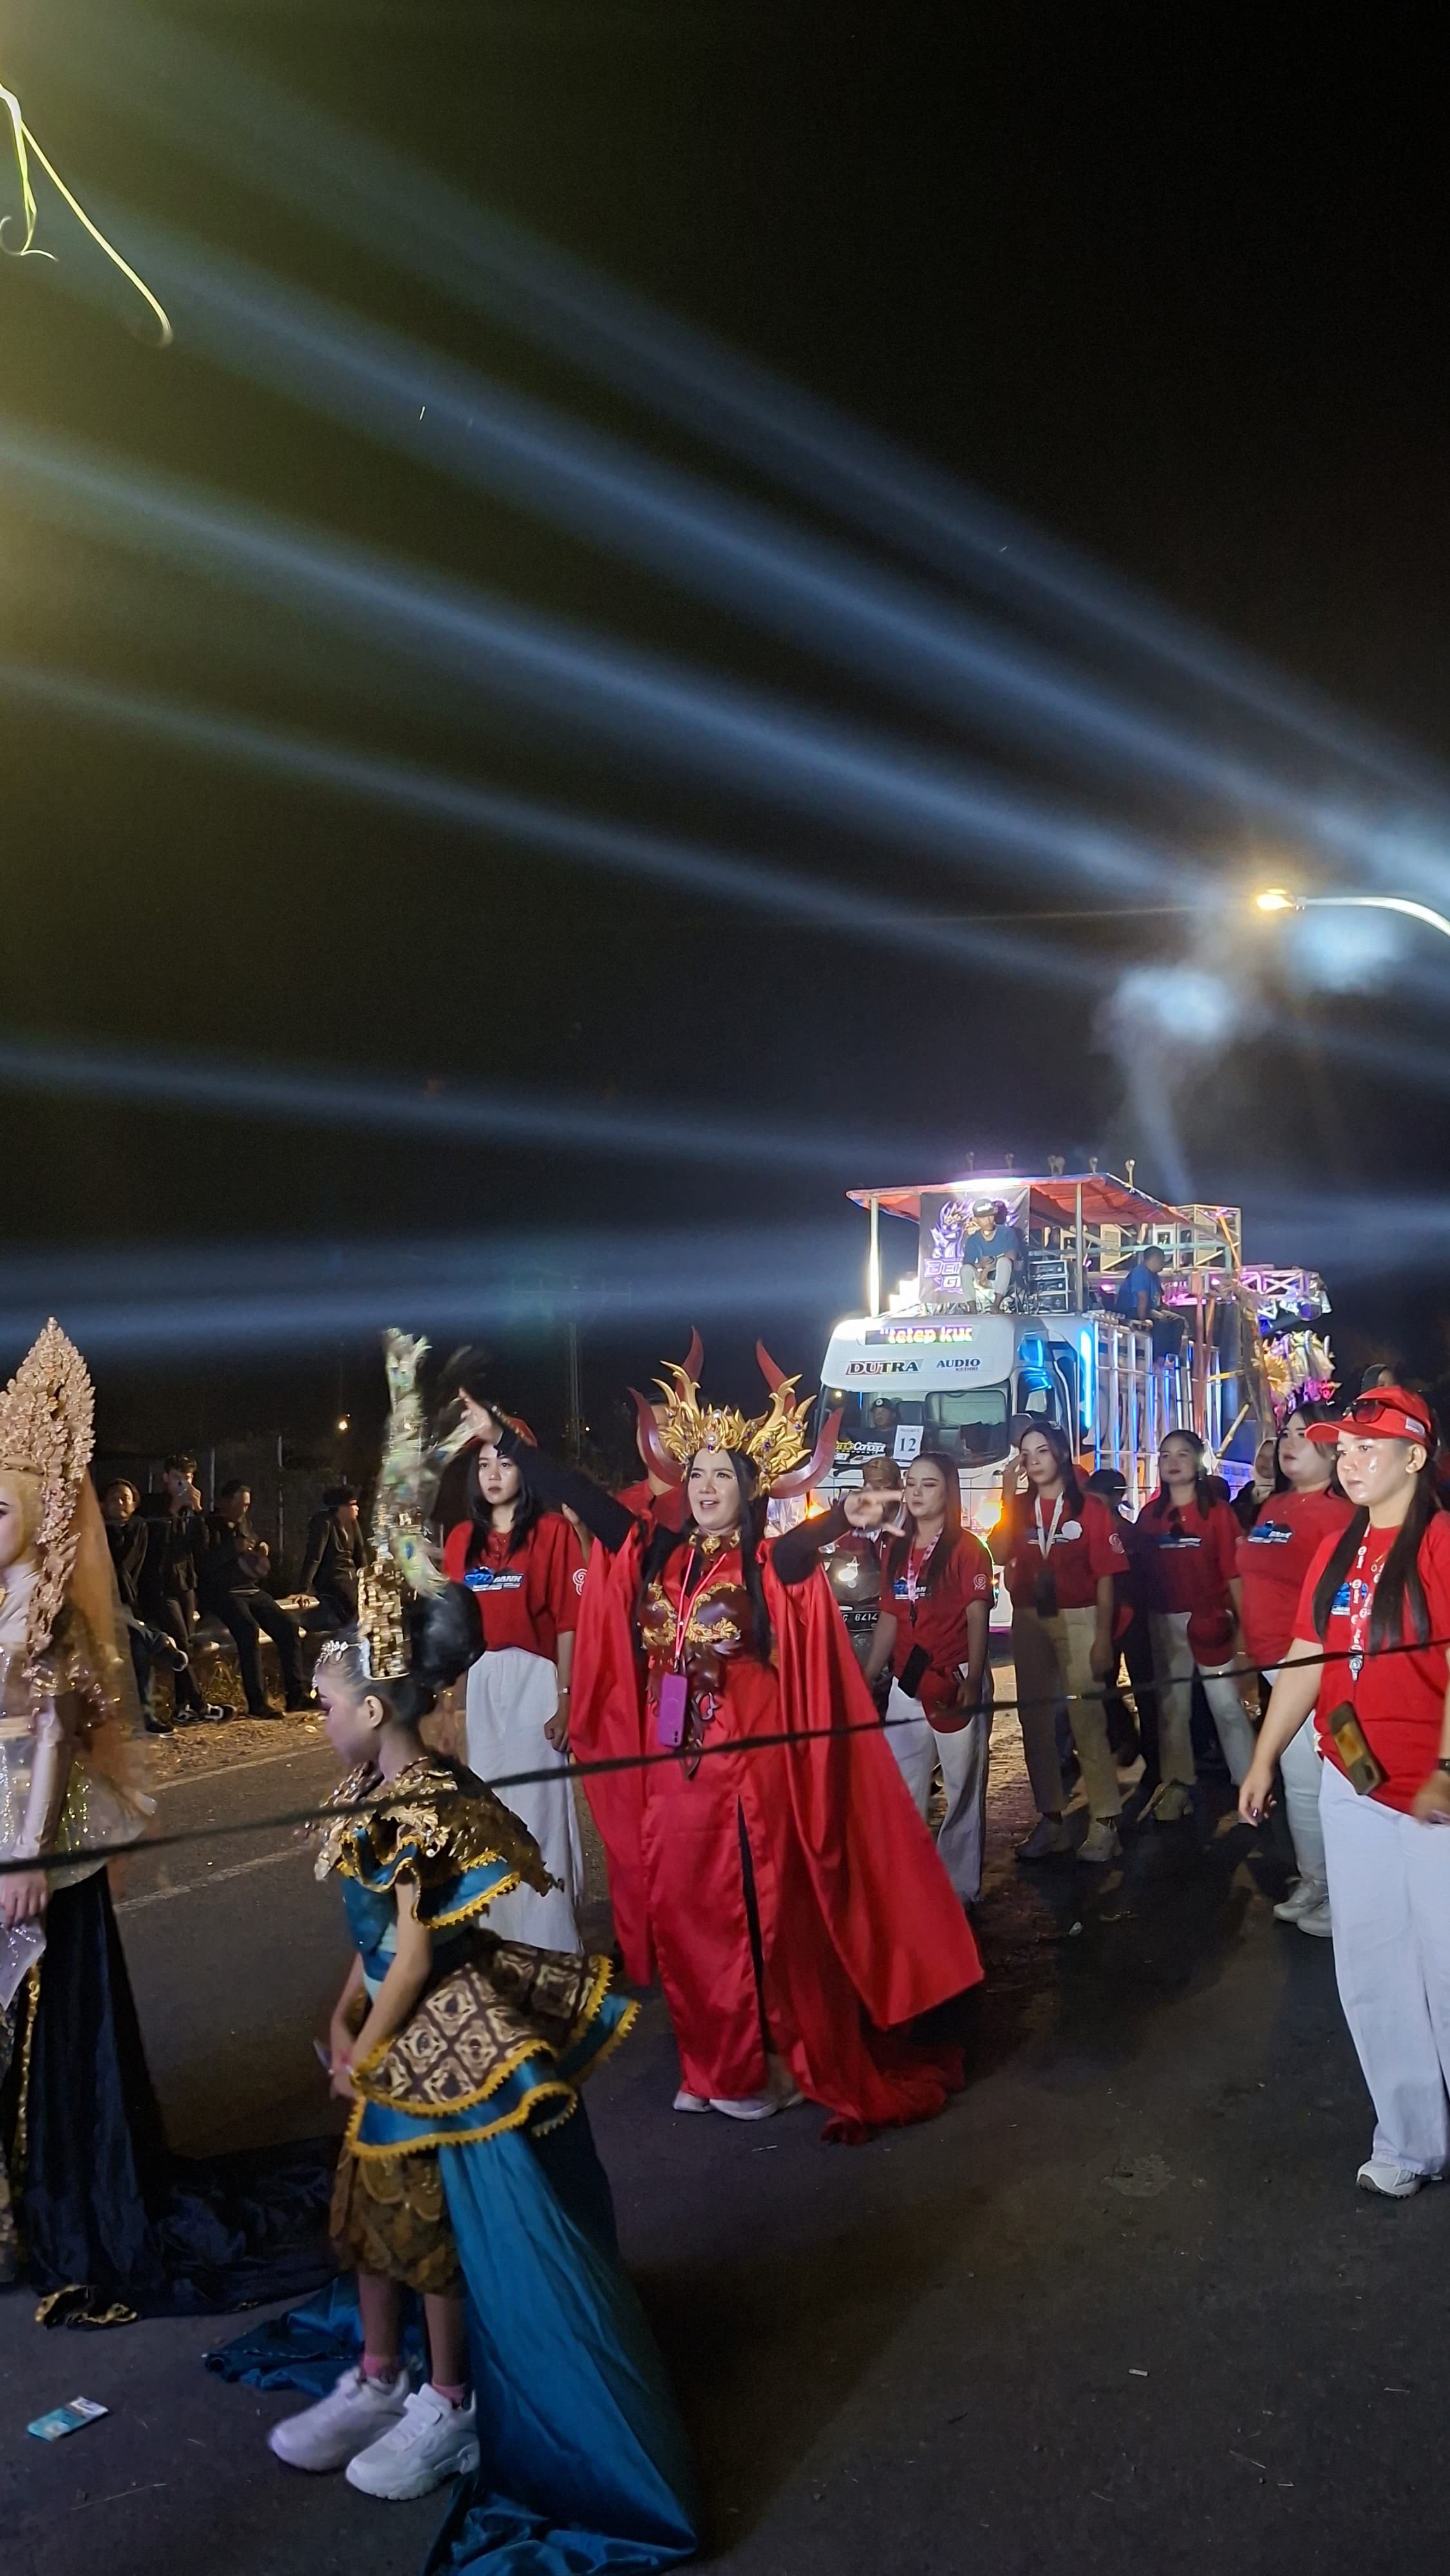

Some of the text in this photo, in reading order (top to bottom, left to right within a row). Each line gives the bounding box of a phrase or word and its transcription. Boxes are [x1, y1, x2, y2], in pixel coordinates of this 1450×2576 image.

[849, 1358, 981, 1373] DUTRA AUDIO
[854, 1441, 887, 1454] Concept
[900, 1437, 917, 1452] 12
